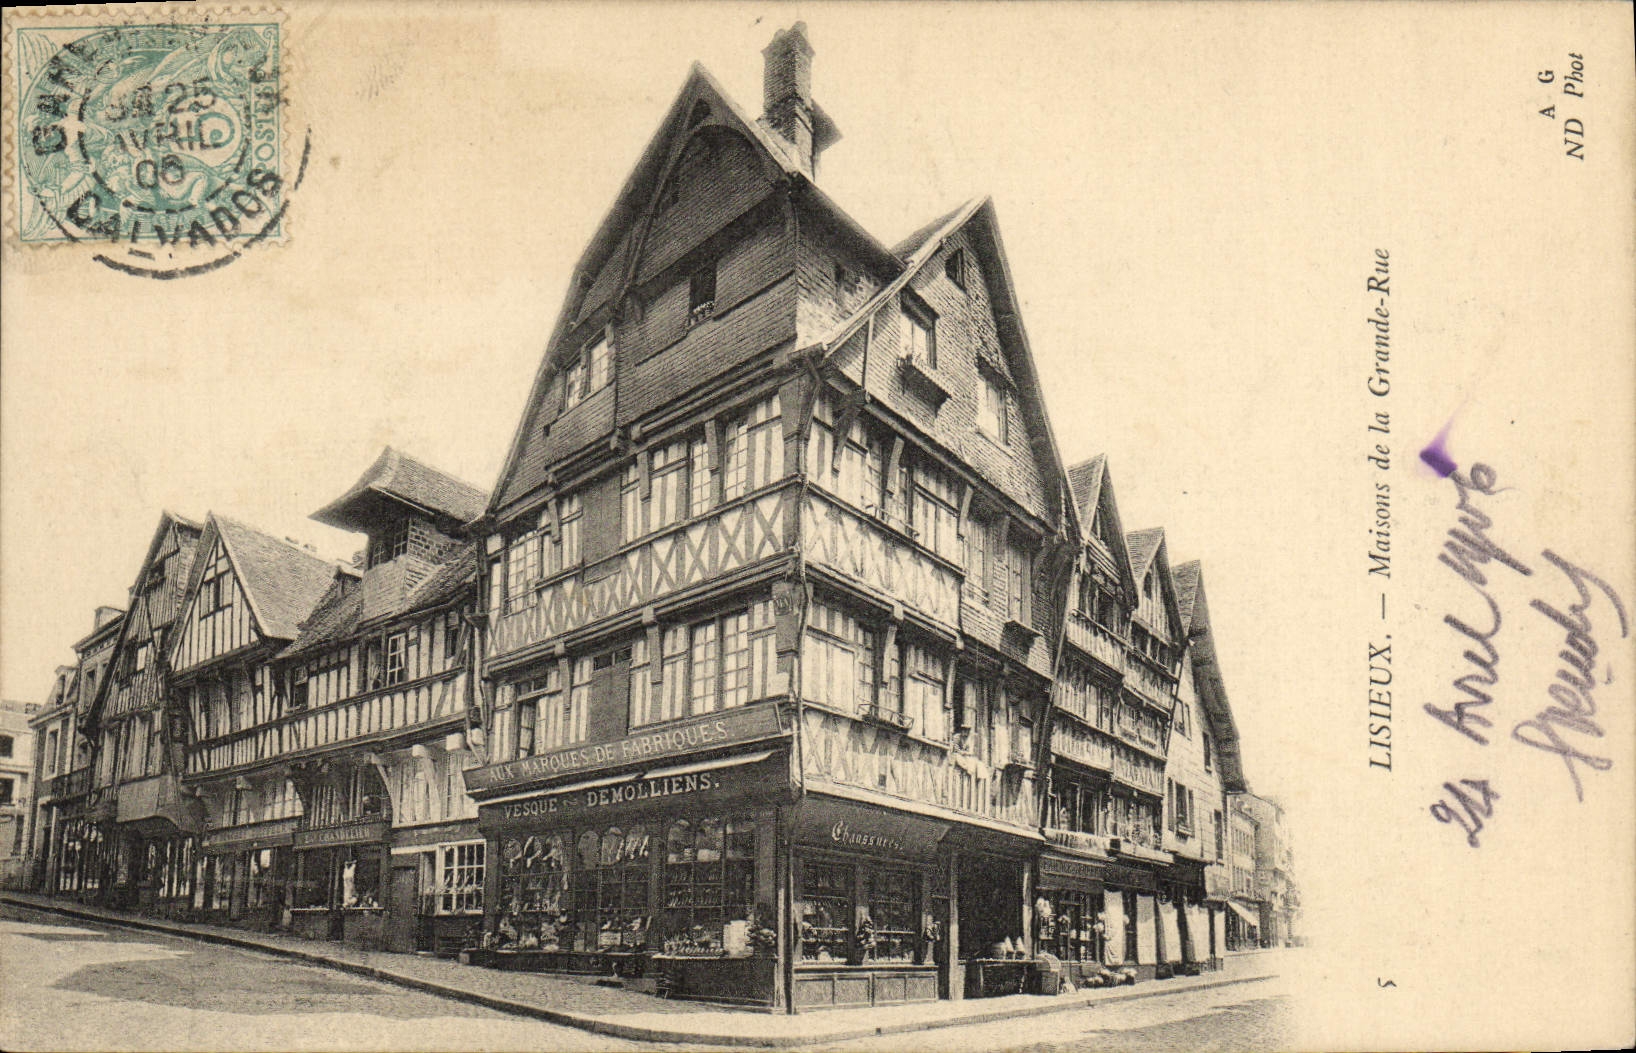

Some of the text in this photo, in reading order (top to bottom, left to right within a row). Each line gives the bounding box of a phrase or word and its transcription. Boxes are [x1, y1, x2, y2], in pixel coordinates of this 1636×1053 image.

[66, 168, 284, 261] CALVADOS
[489, 763, 515, 783] AUX
[521, 748, 589, 777] MARQUES
[594, 744, 615, 763] DE
[504, 798, 558, 819] VESQUE
